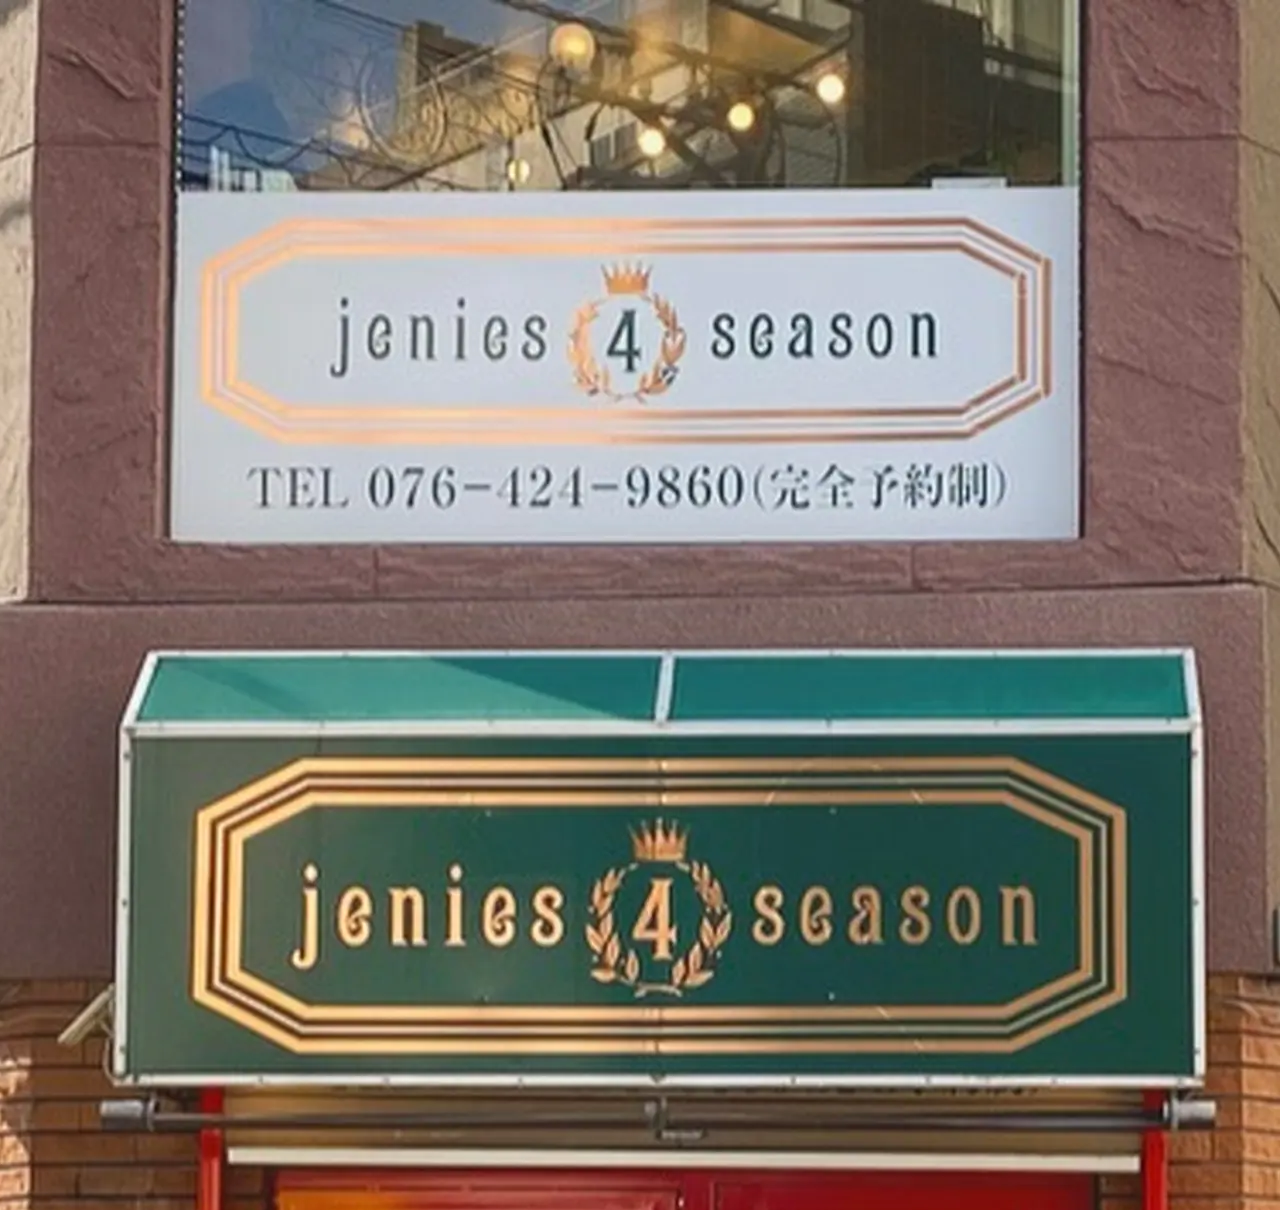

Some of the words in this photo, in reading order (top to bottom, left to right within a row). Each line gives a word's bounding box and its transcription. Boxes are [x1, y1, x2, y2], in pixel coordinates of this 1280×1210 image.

[331, 297, 548, 379] jenies
[606, 309, 642, 373] 4
[709, 312, 940, 359] season
[247, 466, 348, 510] TEL
[293, 865, 566, 971] jenies
[633, 877, 678, 960] 4
[752, 884, 1039, 947] season
